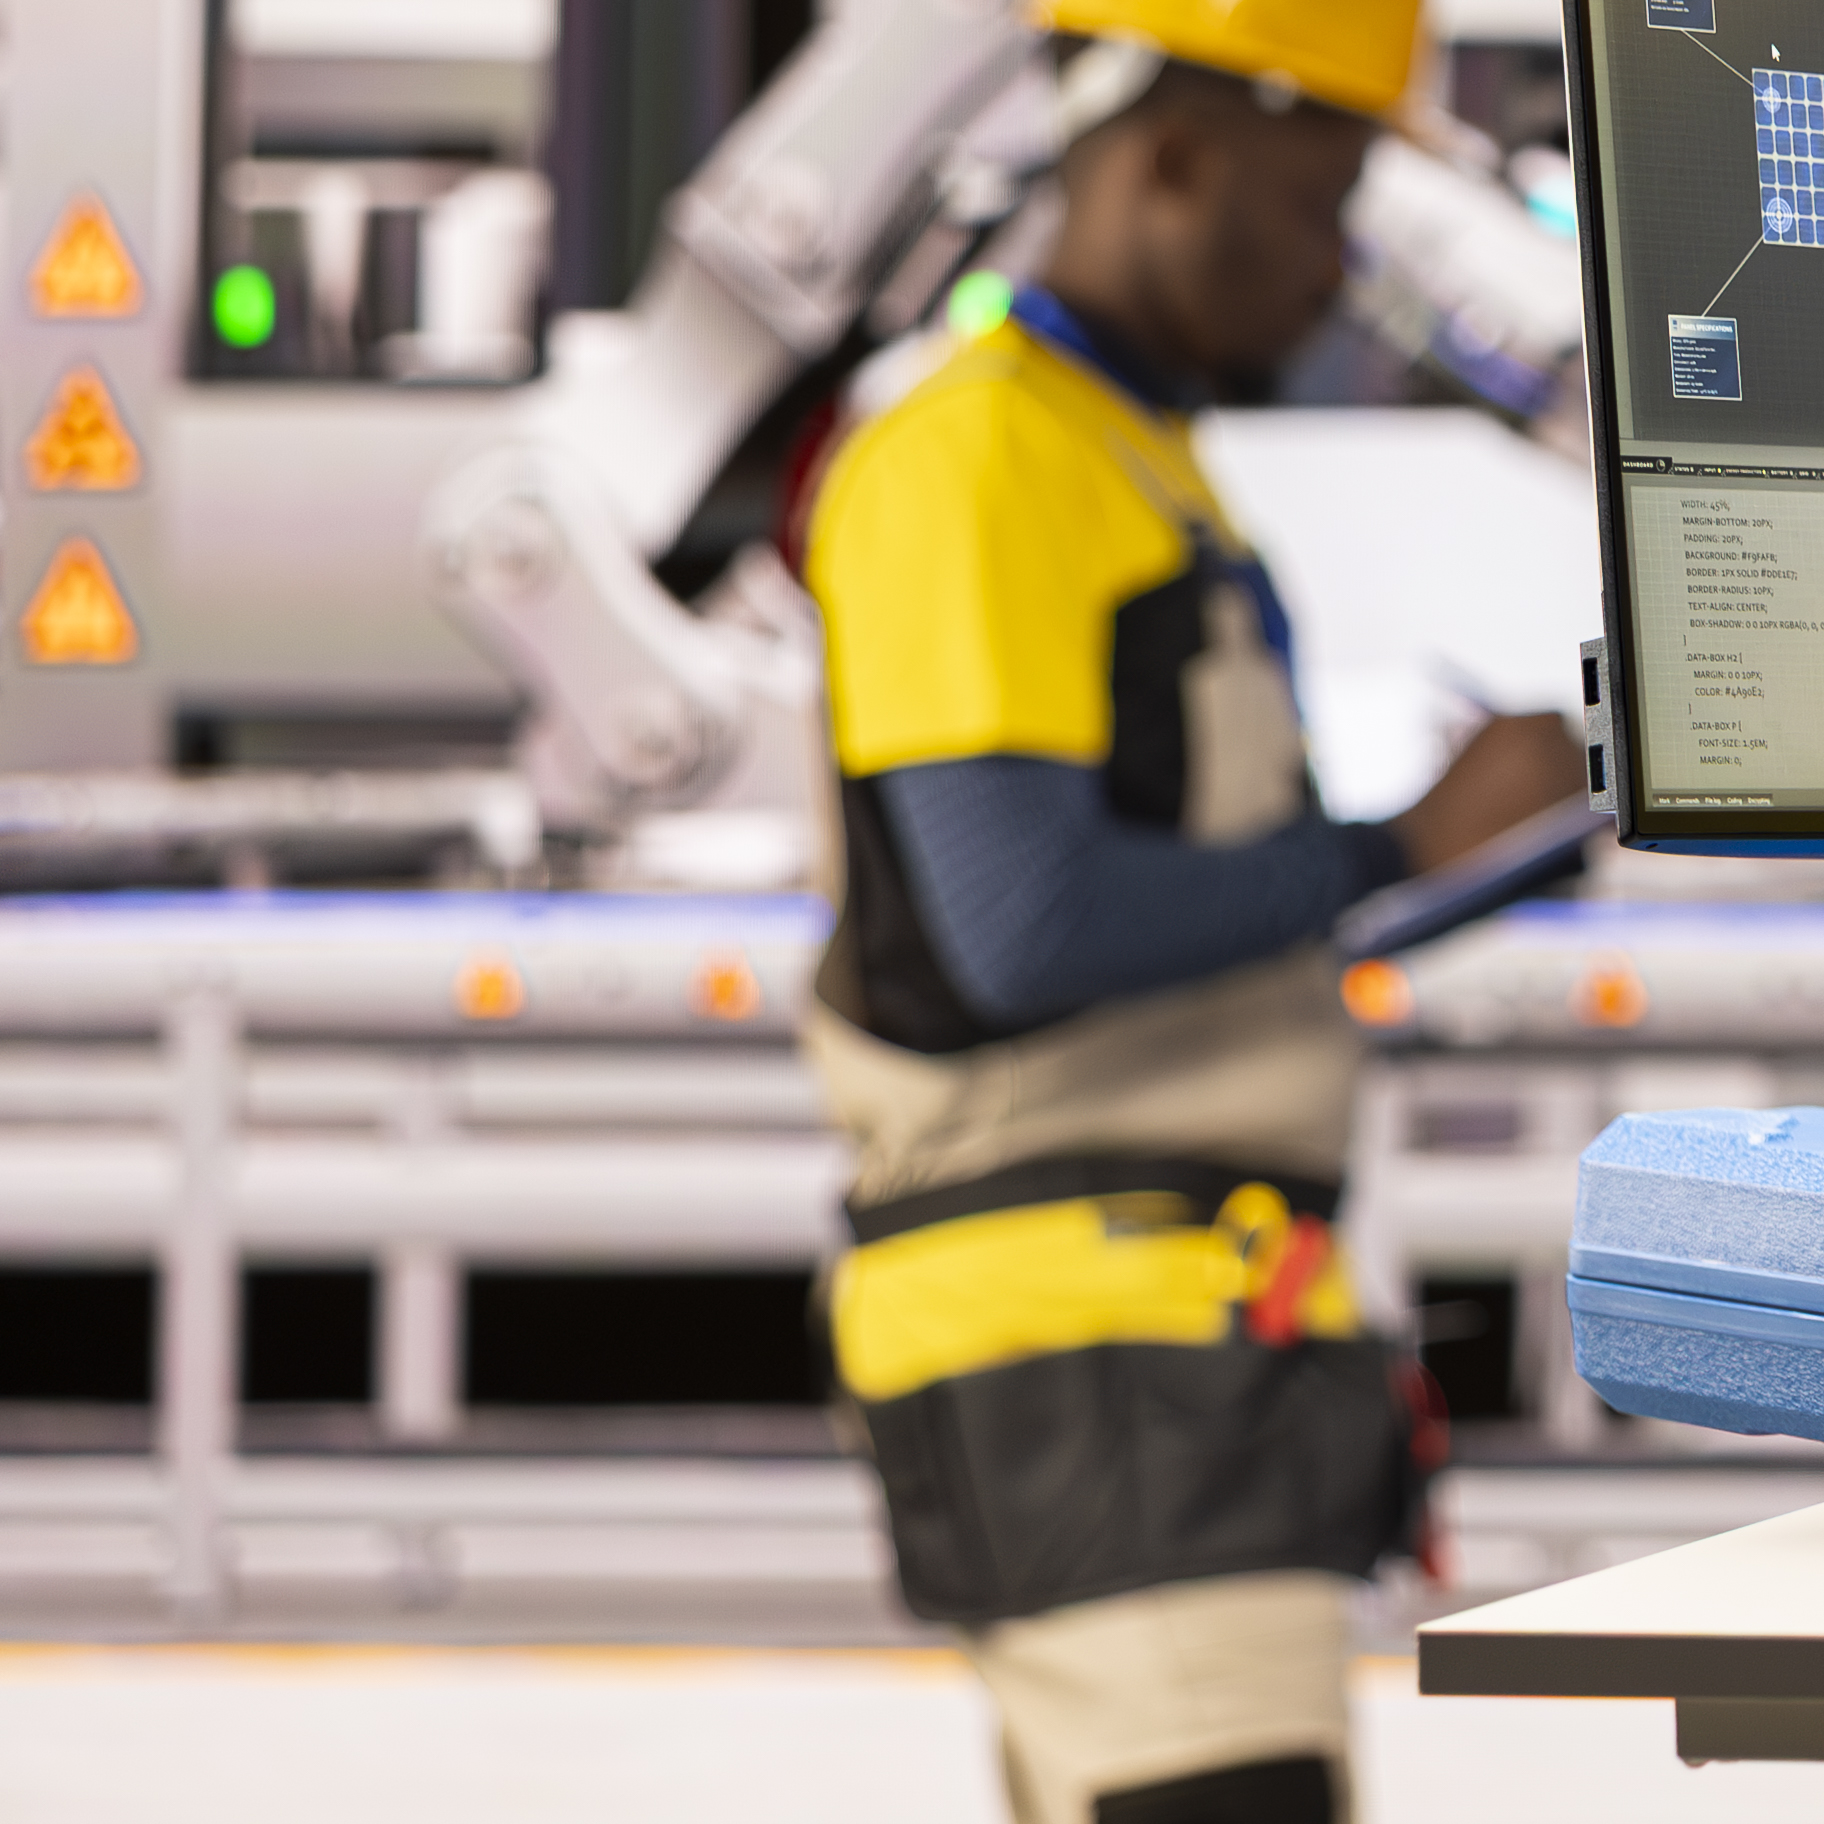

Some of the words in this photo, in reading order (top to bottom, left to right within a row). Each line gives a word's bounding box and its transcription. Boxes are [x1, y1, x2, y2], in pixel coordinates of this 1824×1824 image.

[1680, 499, 1708, 508] WIDTH:
[1682, 517, 1750, 527] MARGIN-BOTTOM:
[1752, 518, 1773, 530] 20PX;
[1684, 533, 1720, 543] PADDING:
[1722, 535, 1743, 546] 20PX;
[1685, 551, 1740, 561] BACKGROUND:
[1741, 552, 1778, 564] #F9FAFB;
[1686, 568, 1719, 577] BORDER:
[1721, 569, 1735, 577] 1PX
[1736, 569, 1759, 578] SOLID
[1761, 568, 1798, 581] #DDE1E7;
[1687, 585, 1751, 595] BORDER-RADIUS:
[1753, 586, 1774, 597] 10PX;
[1688, 602, 1735, 611] TEXT-ALIGN:
[1736, 603, 1768, 614] CENTER;
[1690, 619, 1744, 629] BOX-SHADOW:
[1759, 621, 1778, 629] 10PX
[1685, 653, 1726, 662] .DATA-BOX
[1727, 654, 1738, 662] H2
[1693, 670, 1727, 679] MARGIN:
[1742, 671, 1763, 682] 10PX;
[1695, 687, 1723, 696] COLOR:
[1725, 686, 1765, 699] #4A90E2;
[1690, 721, 1730, 731] .DATA-BOX
[1698, 738, 1741, 748] FONT-SIZE:
[1743, 739, 1768, 751] 1.5EM;
[1700, 756, 1732, 765] MARGIN:
